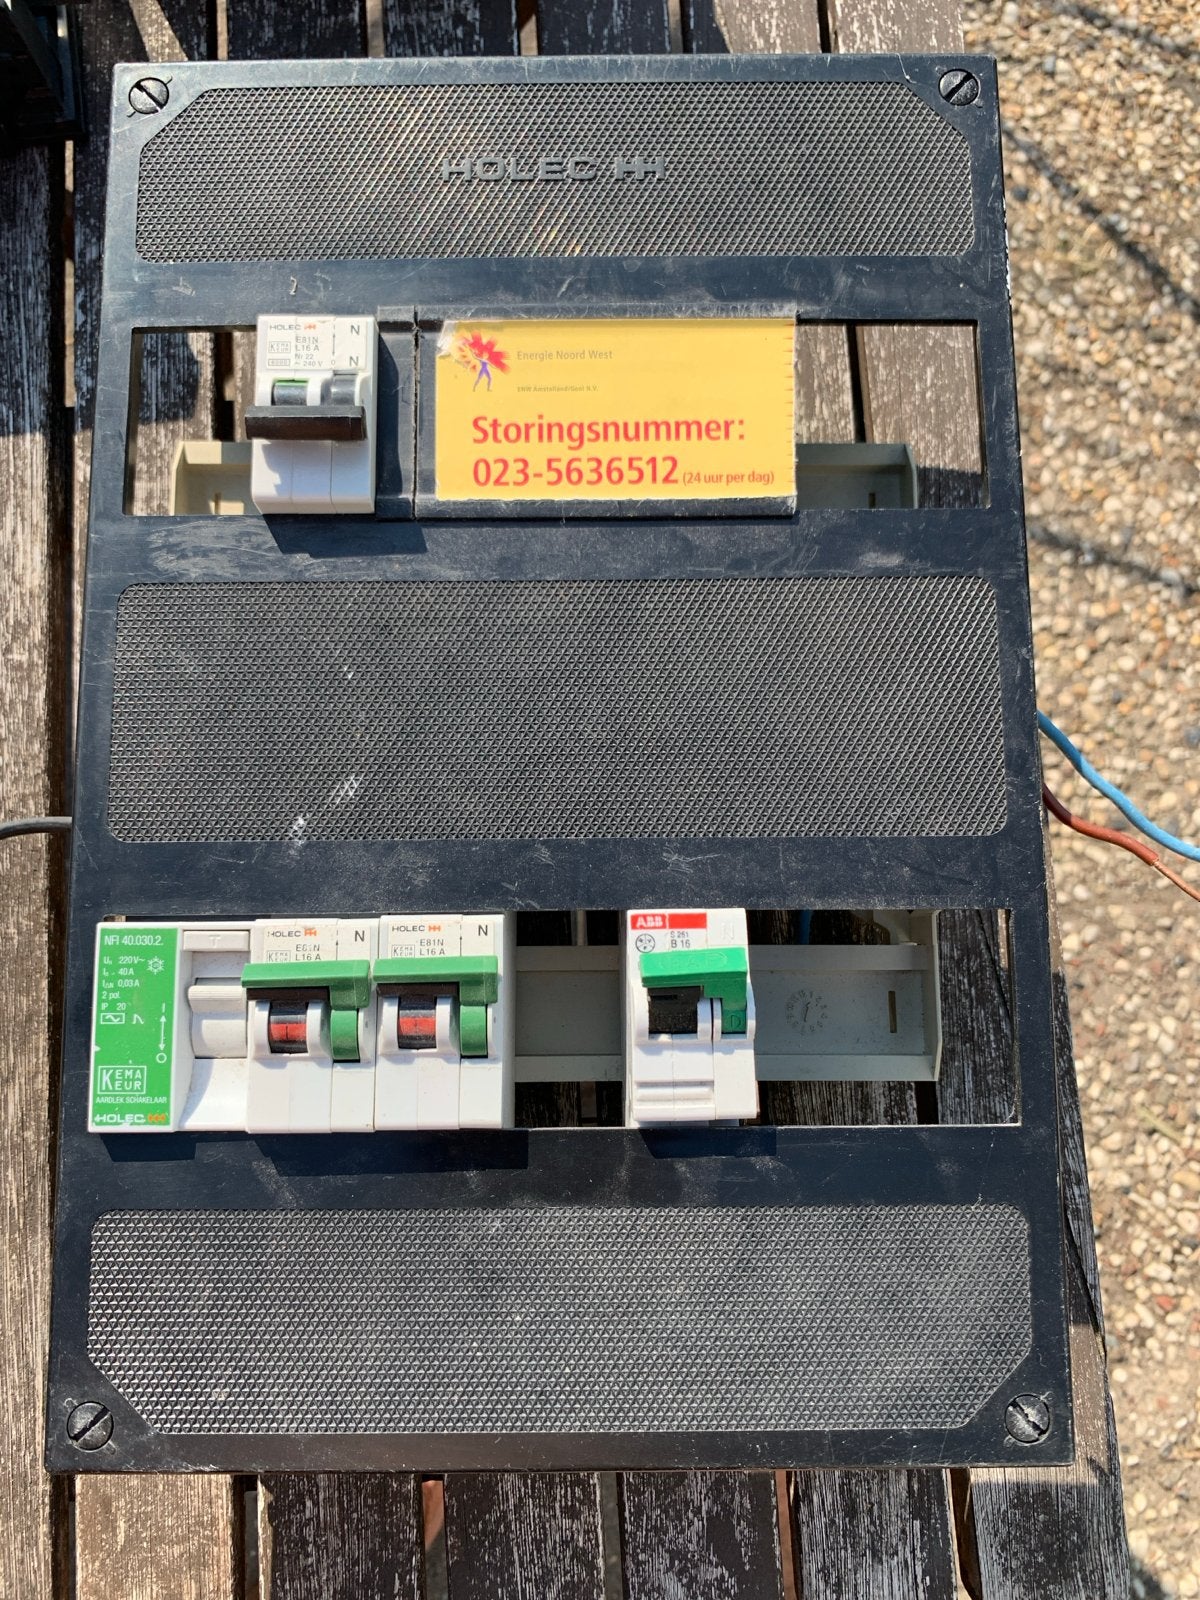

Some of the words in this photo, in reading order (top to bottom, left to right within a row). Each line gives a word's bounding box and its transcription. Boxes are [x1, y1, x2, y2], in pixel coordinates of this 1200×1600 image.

[442, 157, 596, 182] HOLEC
[350, 324, 360, 335] N
[295, 336, 318, 344] E81N
[295, 344, 311, 352] L16
[313, 344, 320, 352] A
[517, 351, 552, 361] Energie
[555, 350, 586, 360] Noord
[588, 349, 613, 360] West
[349, 356, 359, 367] N
[472, 414, 745, 450] Storingsnummer:
[473, 456, 679, 487] 023-5636512
[682, 472, 701, 486] (24
[703, 473, 723, 484] uur
[725, 473, 745, 485] per
[747, 471, 775, 486] dag)
[636, 916, 663, 927] ABB
[478, 924, 488, 936] N
[104, 935, 119, 946] NFI
[354, 930, 365, 942] N
[420, 939, 444, 947] E81N
[671, 940, 677, 948] B
[680, 939, 691, 948] 16
[420, 947, 436, 955] L16
[439, 947, 446, 955] A
[295, 953, 311, 961] L16
[102, 991, 107, 999] 2
[96, 1096, 125, 1104] AARDLEK
[125, 1096, 167, 1104] SCHAKELAAR
[94, 1113, 145, 1123] HOLEC
